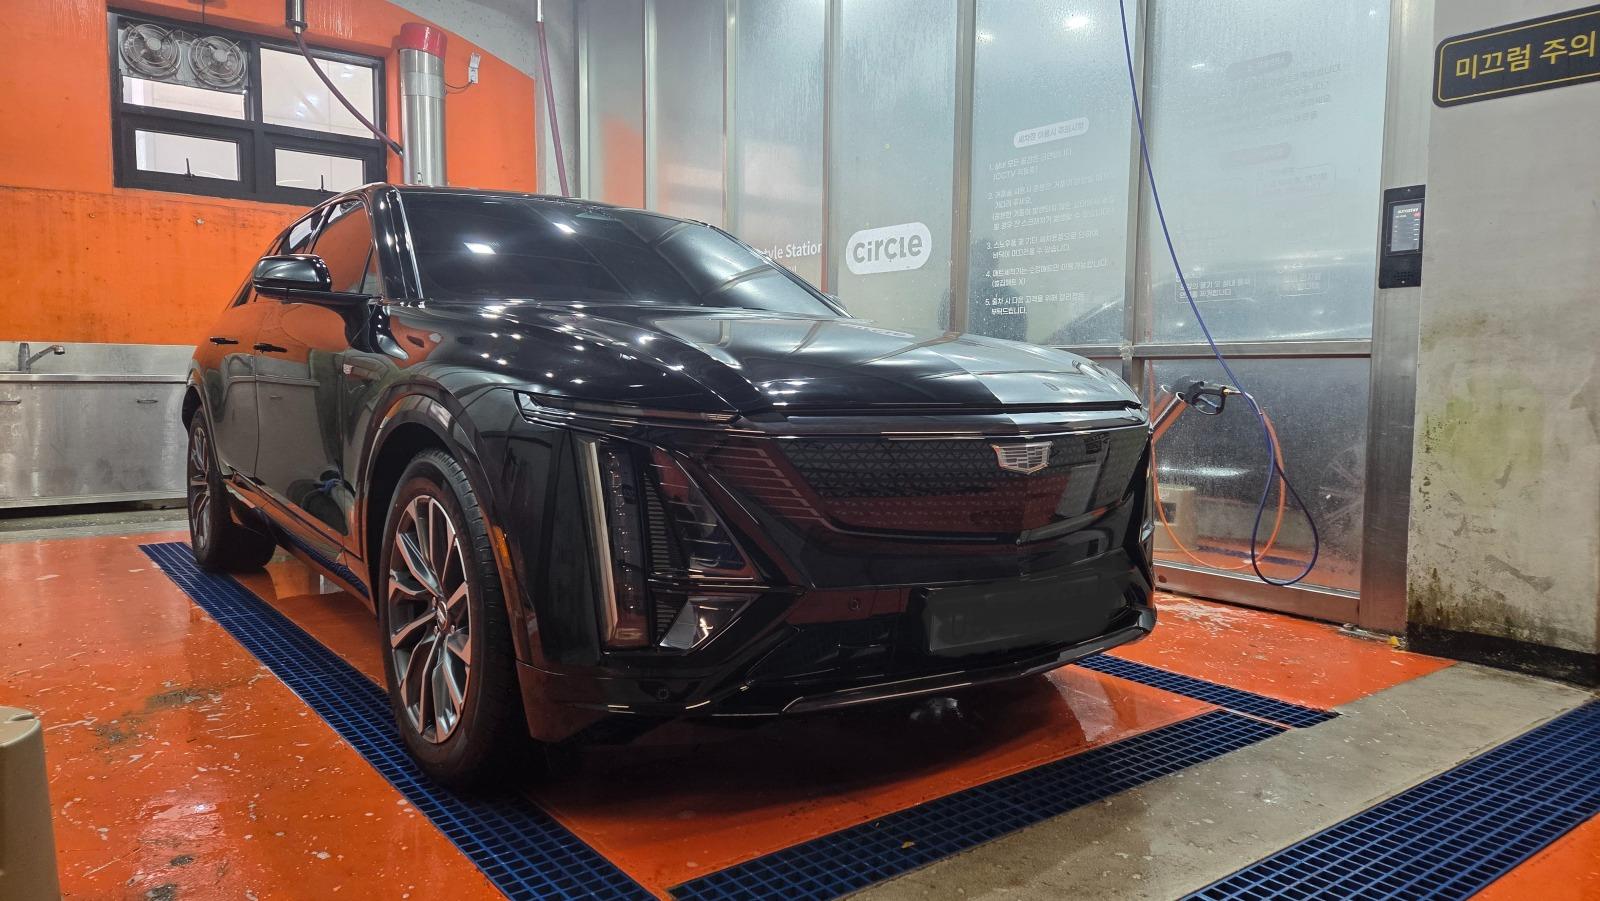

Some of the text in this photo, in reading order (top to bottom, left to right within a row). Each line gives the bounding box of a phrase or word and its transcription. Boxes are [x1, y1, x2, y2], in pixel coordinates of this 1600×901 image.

[1455, 30, 1597, 80] 미끄럼 주의
[852, 234, 924, 264] circle
[1012, 295, 1024, 304] 다음
